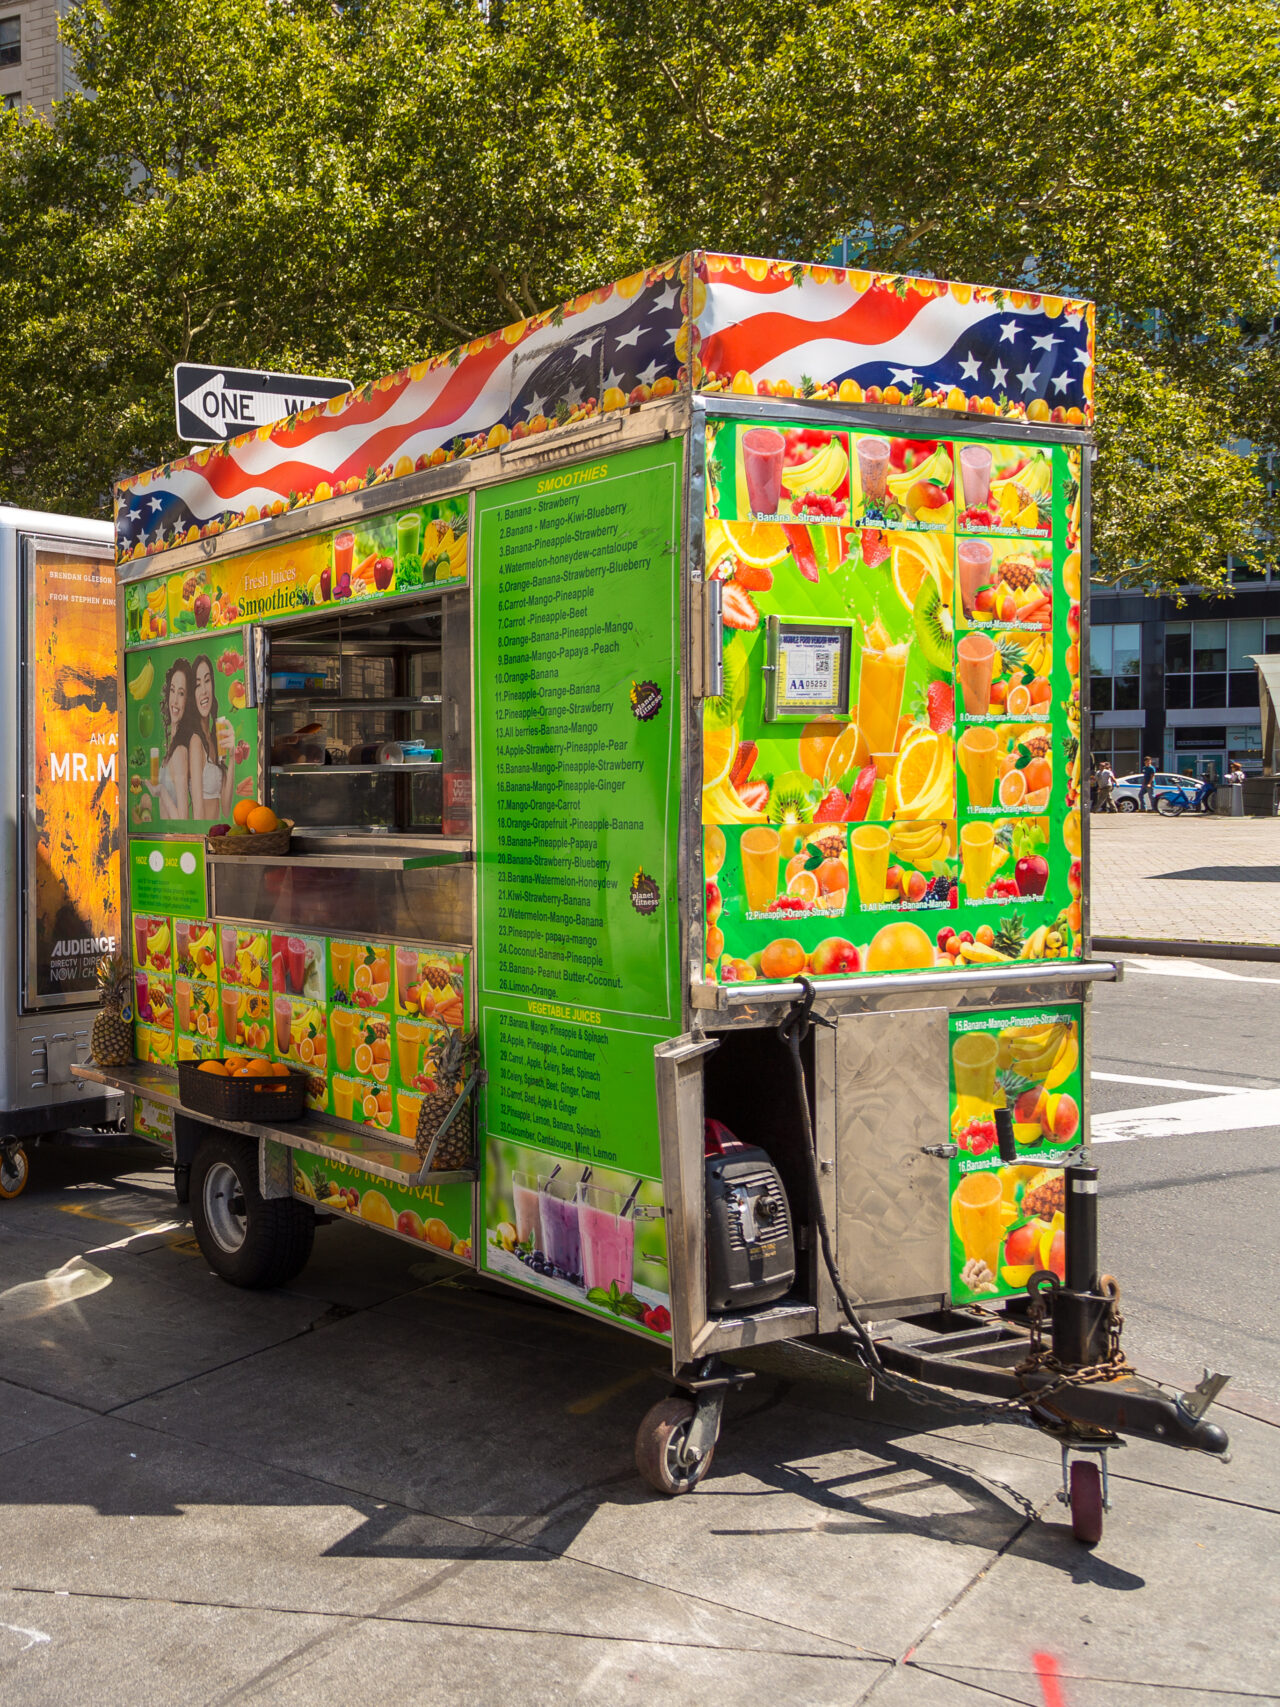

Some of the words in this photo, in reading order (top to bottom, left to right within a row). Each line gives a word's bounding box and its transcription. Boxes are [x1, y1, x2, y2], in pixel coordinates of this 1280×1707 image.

[203, 391, 255, 421] ONE
[537, 464, 608, 493] SMOOTHIES
[498, 512, 503, 522] 1.
[505, 506, 531, 521] Banana
[539, 494, 580, 513] Strawberry
[499, 523, 532, 540] 2.Banana
[539, 502, 627, 531] Mango-Kiwi-Blueberry
[748, 513, 755, 521] 1.
[757, 512, 790, 522] Banana
[798, 514, 841, 525] Strawberry
[920, 522, 946, 532] Blueberry
[499, 523, 618, 558] 3.Banana-Pineapple-Strawberry
[1020, 527, 1048, 537] Strawberry
[499, 539, 638, 576] 4.Watermelon-honeydew-cantaloupe
[50, 572, 81, 580] BRENDAN
[84, 575, 112, 583] GLEESON
[245, 572, 268, 590] Fresh
[269, 568, 296, 589] Juices
[499, 556, 652, 594] 5.Orange-Banana-Strawberry-Blueberry
[50, 593, 68, 601] FROM
[71, 596, 100, 604] STEPHEN
[239, 586, 303, 617] Smoothies
[498, 586, 594, 611] 6.Carrot-Mango-Pineapple
[498, 618, 525, 630] 7.Carrot
[527, 605, 587, 625] -Pineapple-Beet
[498, 620, 633, 648] 8.Orange-Banana-Pineapple-Mango
[498, 646, 589, 666] 9.Banana-Mango-Papaya
[591, 640, 620, 654] -Peach
[495, 668, 559, 684] 10.Orange-Banana
[790, 680, 804, 689] AA
[495, 683, 600, 702] 11.Pineapple-Orange-Banana
[495, 702, 614, 720] 12.Pineapple-Orange-Strawberry
[634, 692, 656, 716] planet
[639, 694, 663, 717] fitness
[90, 733, 105, 744] AN
[496, 726, 513, 738] 13.All
[515, 722, 598, 737] berries-Banana-Mango
[496, 739, 628, 757] 14.Apple-Strawberry-Pineapple-Pear
[496, 759, 644, 775] 15.Banana-Mango-Pineapple-Strawberry
[497, 779, 625, 793] 16.Banana-Mango-Pineapple-Ginger
[497, 799, 581, 812] 17.Mango-Orange-Carrot
[497, 818, 567, 831] 18.Orange-Grapefruit
[570, 818, 644, 832] -Pineapple-Banana
[498, 836, 598, 851] 19.Banana-Pineapple-Papaya
[498, 853, 611, 872] 20.Banana-Strawberry-Blueberry
[498, 872, 618, 891] 23.Banana-Watermelon-Honeydew
[498, 889, 591, 907] 21.Kiwi-Strawberry-Banana
[632, 892, 654, 900] planet
[635, 898, 659, 906] fitness
[878, 900, 951, 911] berries-Banana-Mango
[498, 907, 604, 927] 22.Watermelon-Mango-Banana
[498, 925, 544, 942] 23.Pineapple-
[545, 931, 597, 948] papaya-mango
[51, 936, 115, 957] AUDIENCE
[499, 944, 603, 967] 24.Coconut-Banana-Pineapple
[51, 958, 77, 968] DIRECTV
[51, 967, 77, 981] NOW
[499, 961, 537, 977] 25.Banana-
[537, 966, 561, 979] Peanut
[563, 968, 623, 989] Butter-Coconut.
[499, 978, 558, 998] 26.Limon-Orange.
[528, 1001, 570, 1019] VEGETABLE
[572, 1008, 601, 1024] JUICES
[955, 1013, 1071, 1031] 15.Banana-Mango-Pineapple-Strawberry
[550, 1024, 577, 1039] Pineapple
[578, 1029, 583, 1039] &
[584, 1029, 609, 1045] Spinach
[560, 1045, 595, 1062] Cucumber
[577, 1067, 600, 1081] Spinach
[582, 1086, 600, 1101] Carrot
[559, 1100, 578, 1116] Ginger
[576, 1123, 601, 1139] Spinach
[593, 1146, 617, 1162] Lemon
